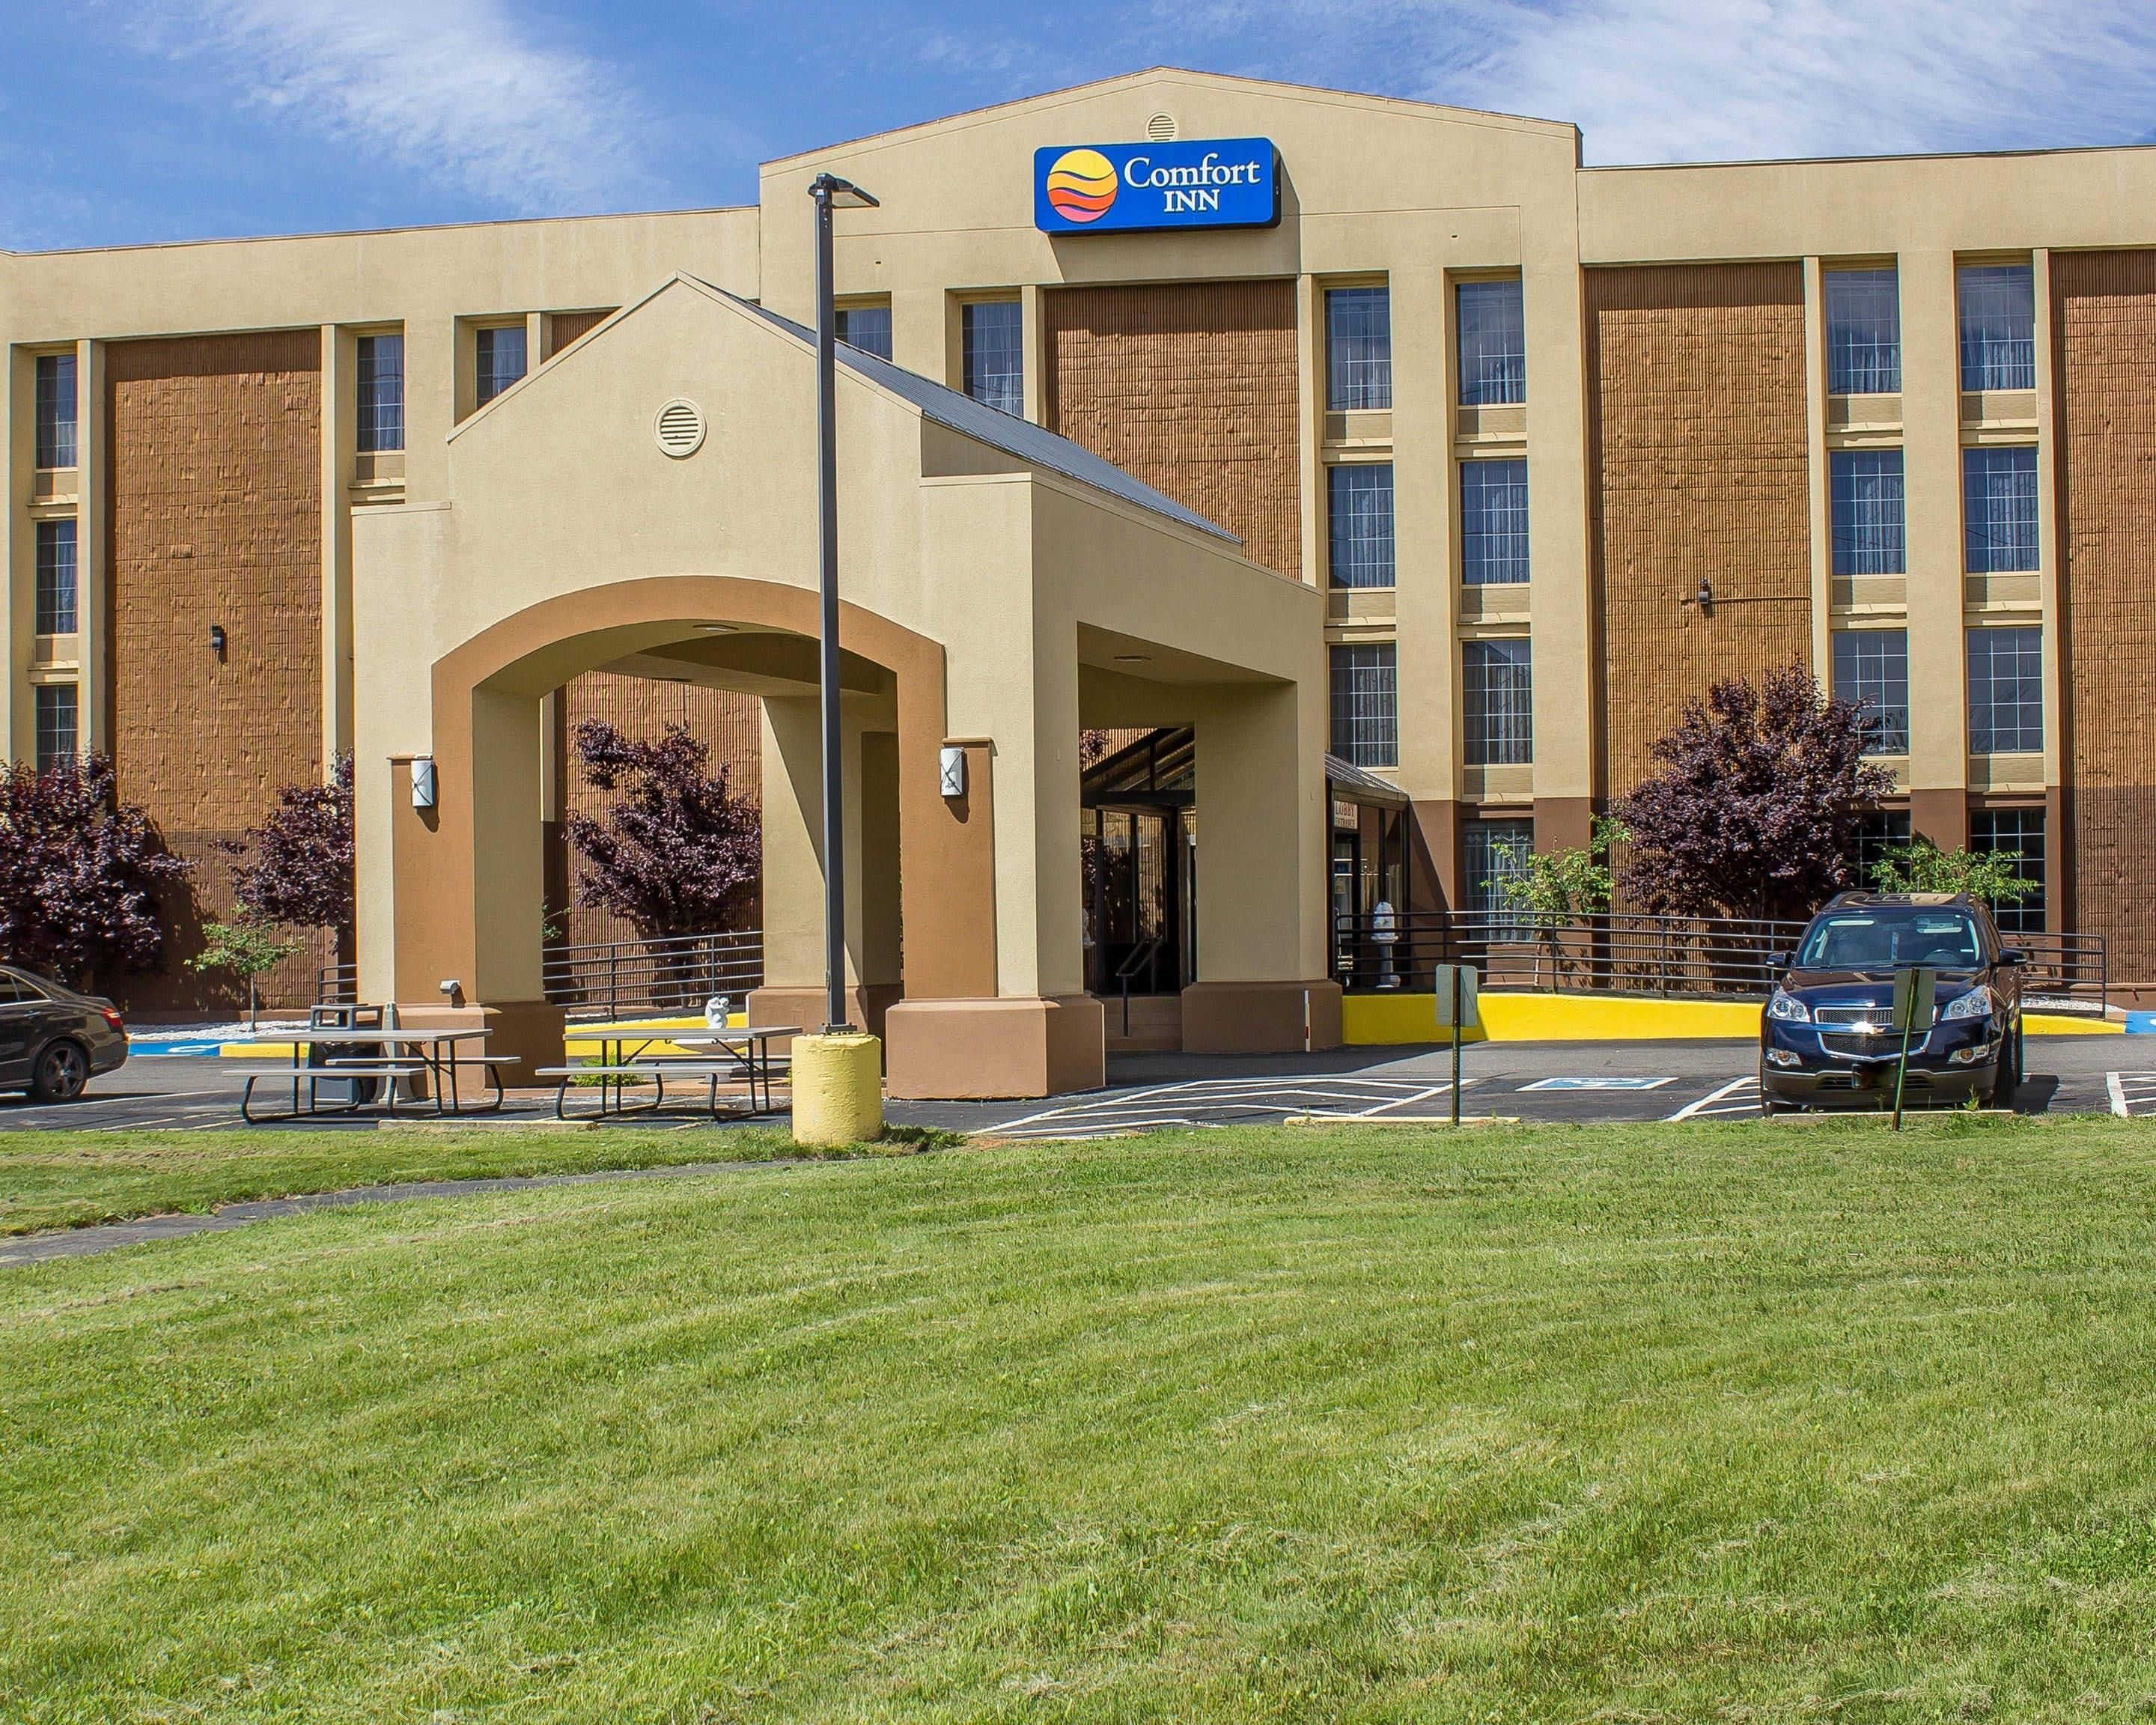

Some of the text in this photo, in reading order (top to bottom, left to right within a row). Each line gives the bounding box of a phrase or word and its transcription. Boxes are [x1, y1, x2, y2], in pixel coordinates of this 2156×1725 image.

[1124, 153, 1261, 188] Comfort
[1163, 189, 1220, 213] INN
[1336, 802, 1354, 817] LOBBY
